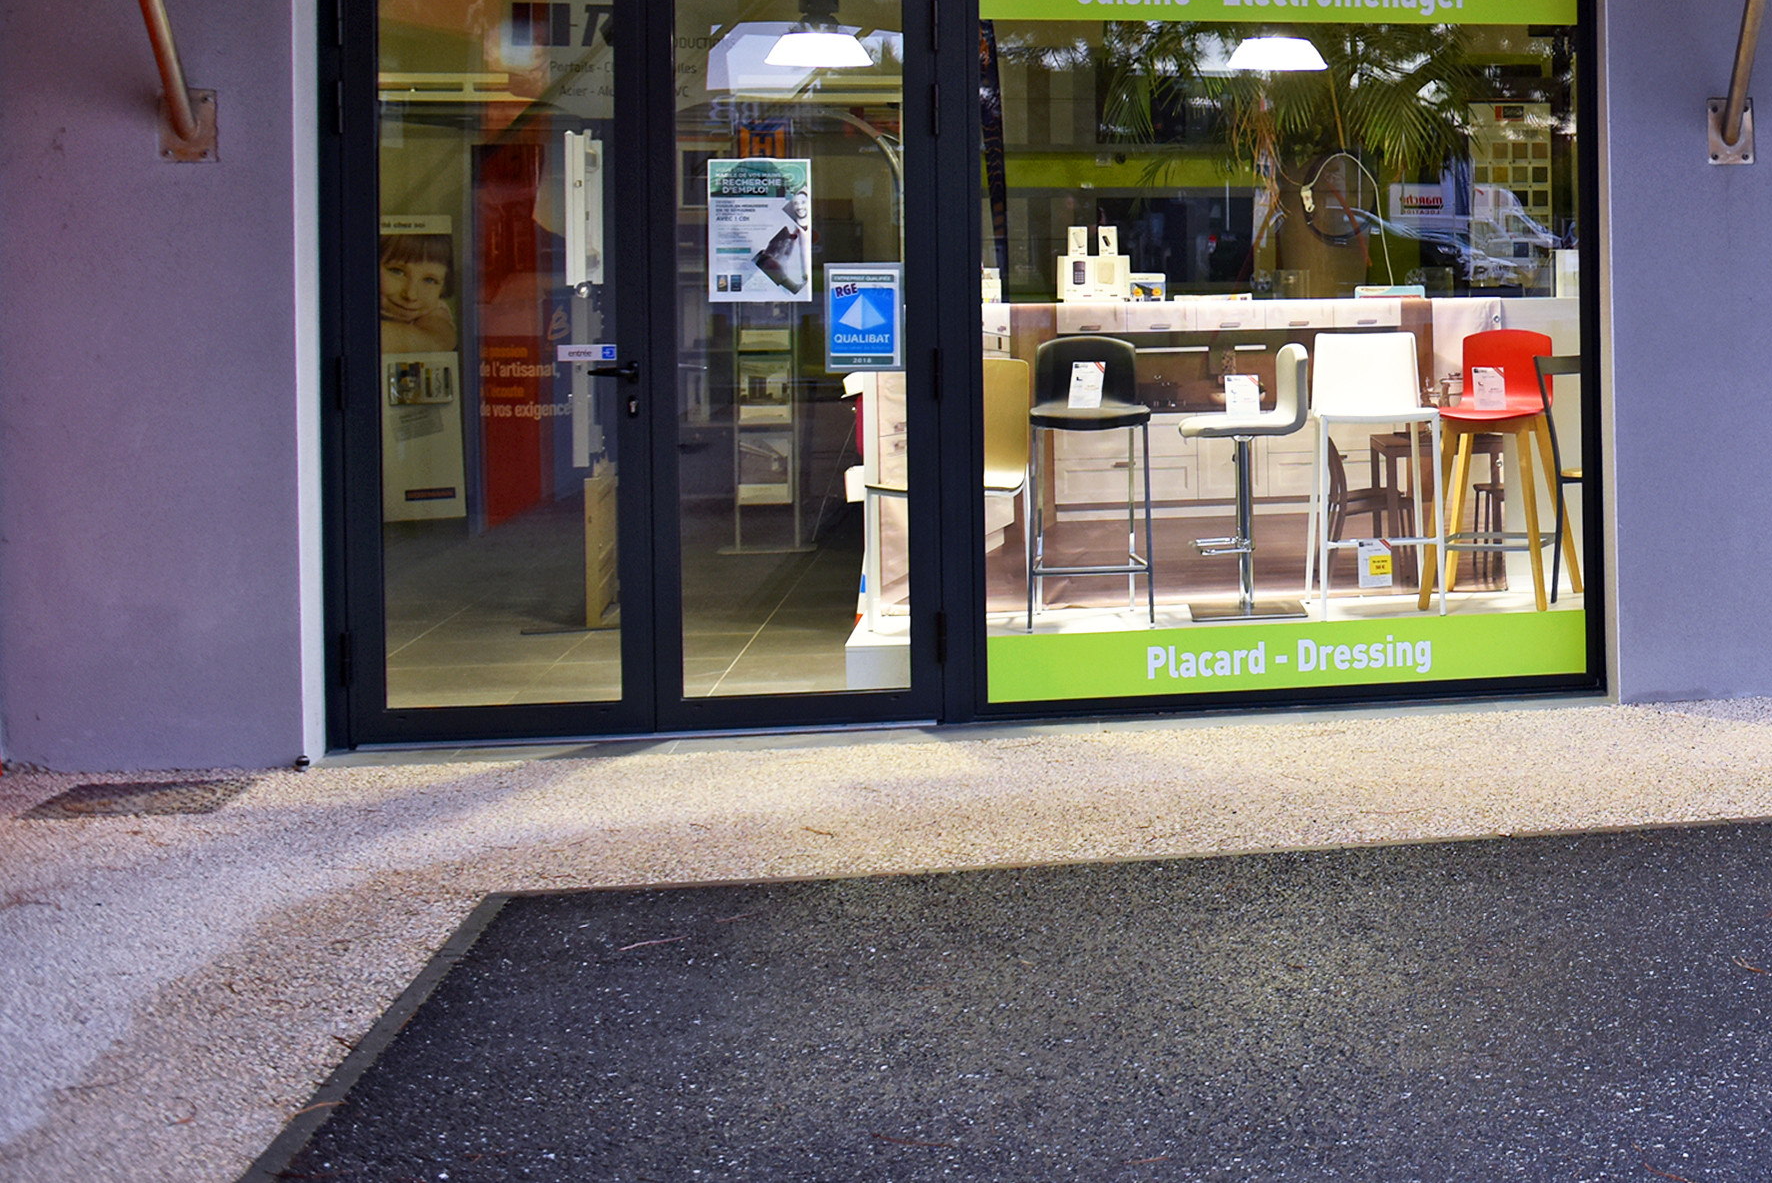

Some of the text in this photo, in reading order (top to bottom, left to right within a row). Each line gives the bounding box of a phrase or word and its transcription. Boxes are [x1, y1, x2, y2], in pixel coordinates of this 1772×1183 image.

[722, 178, 782, 187] RECHERCHE
[835, 283, 858, 298] RGE
[834, 333, 890, 344] QUALIBAT
[567, 349, 593, 357] entrée
[493, 404, 513, 417] vos
[1146, 641, 1266, 680] Placard
[1297, 634, 1433, 675] Dressing
